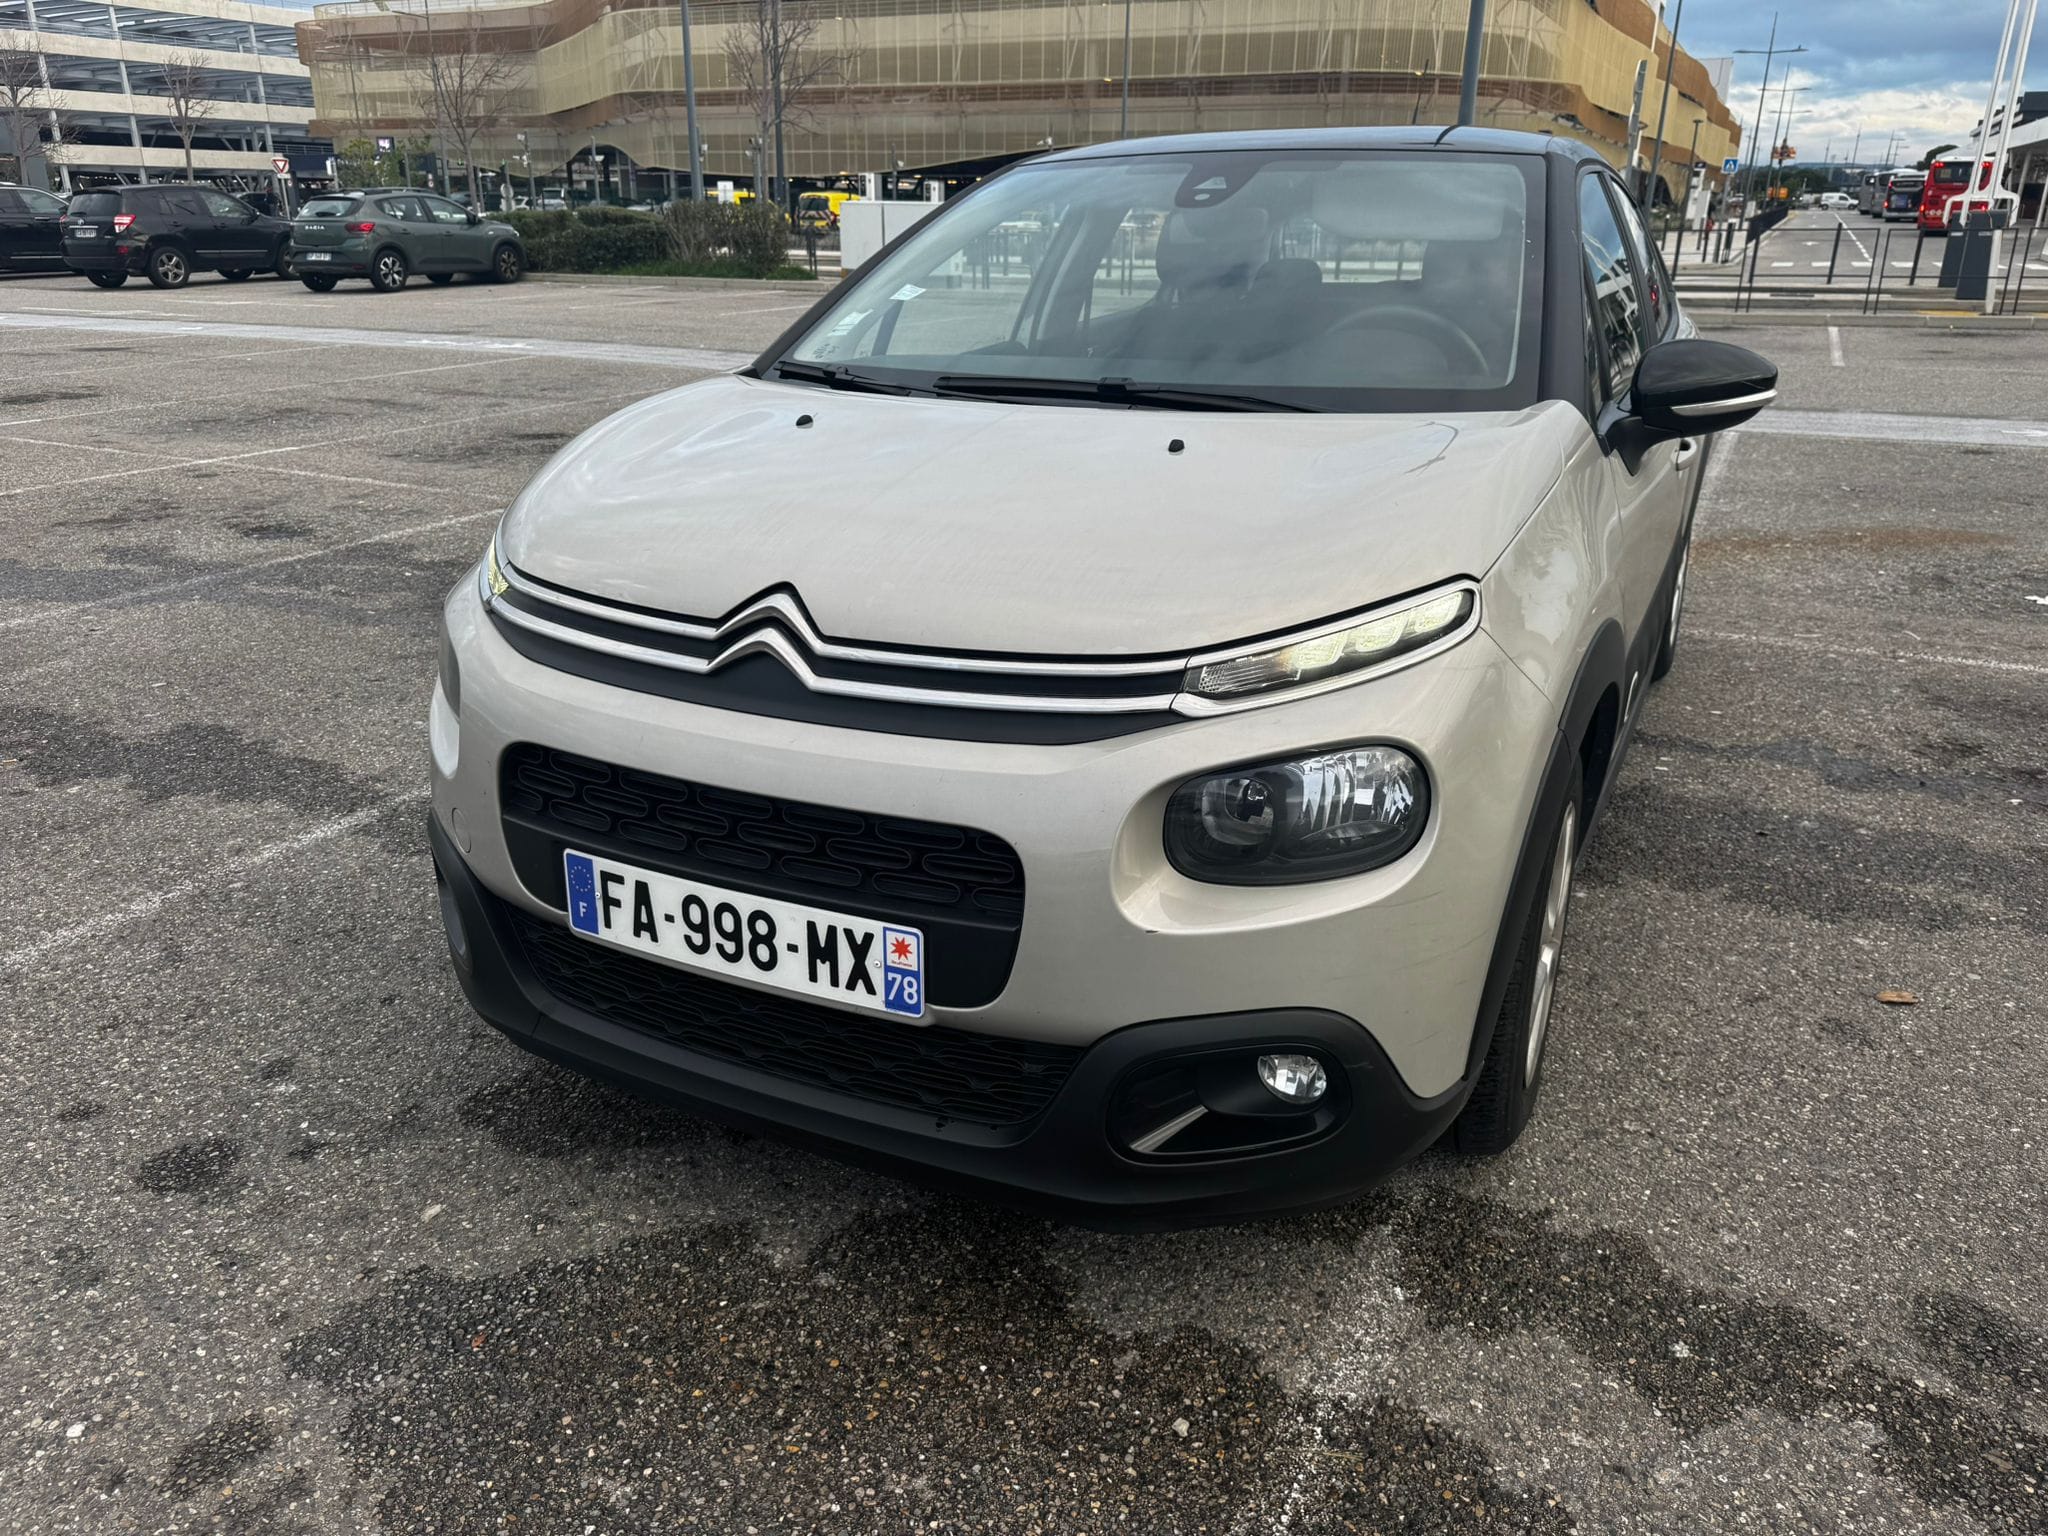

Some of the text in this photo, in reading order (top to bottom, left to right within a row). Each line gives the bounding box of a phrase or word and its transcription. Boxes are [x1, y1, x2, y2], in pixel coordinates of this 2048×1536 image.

[579, 900, 588, 918] F
[600, 869, 877, 996] FA-998-MX
[887, 971, 919, 1005] 78
